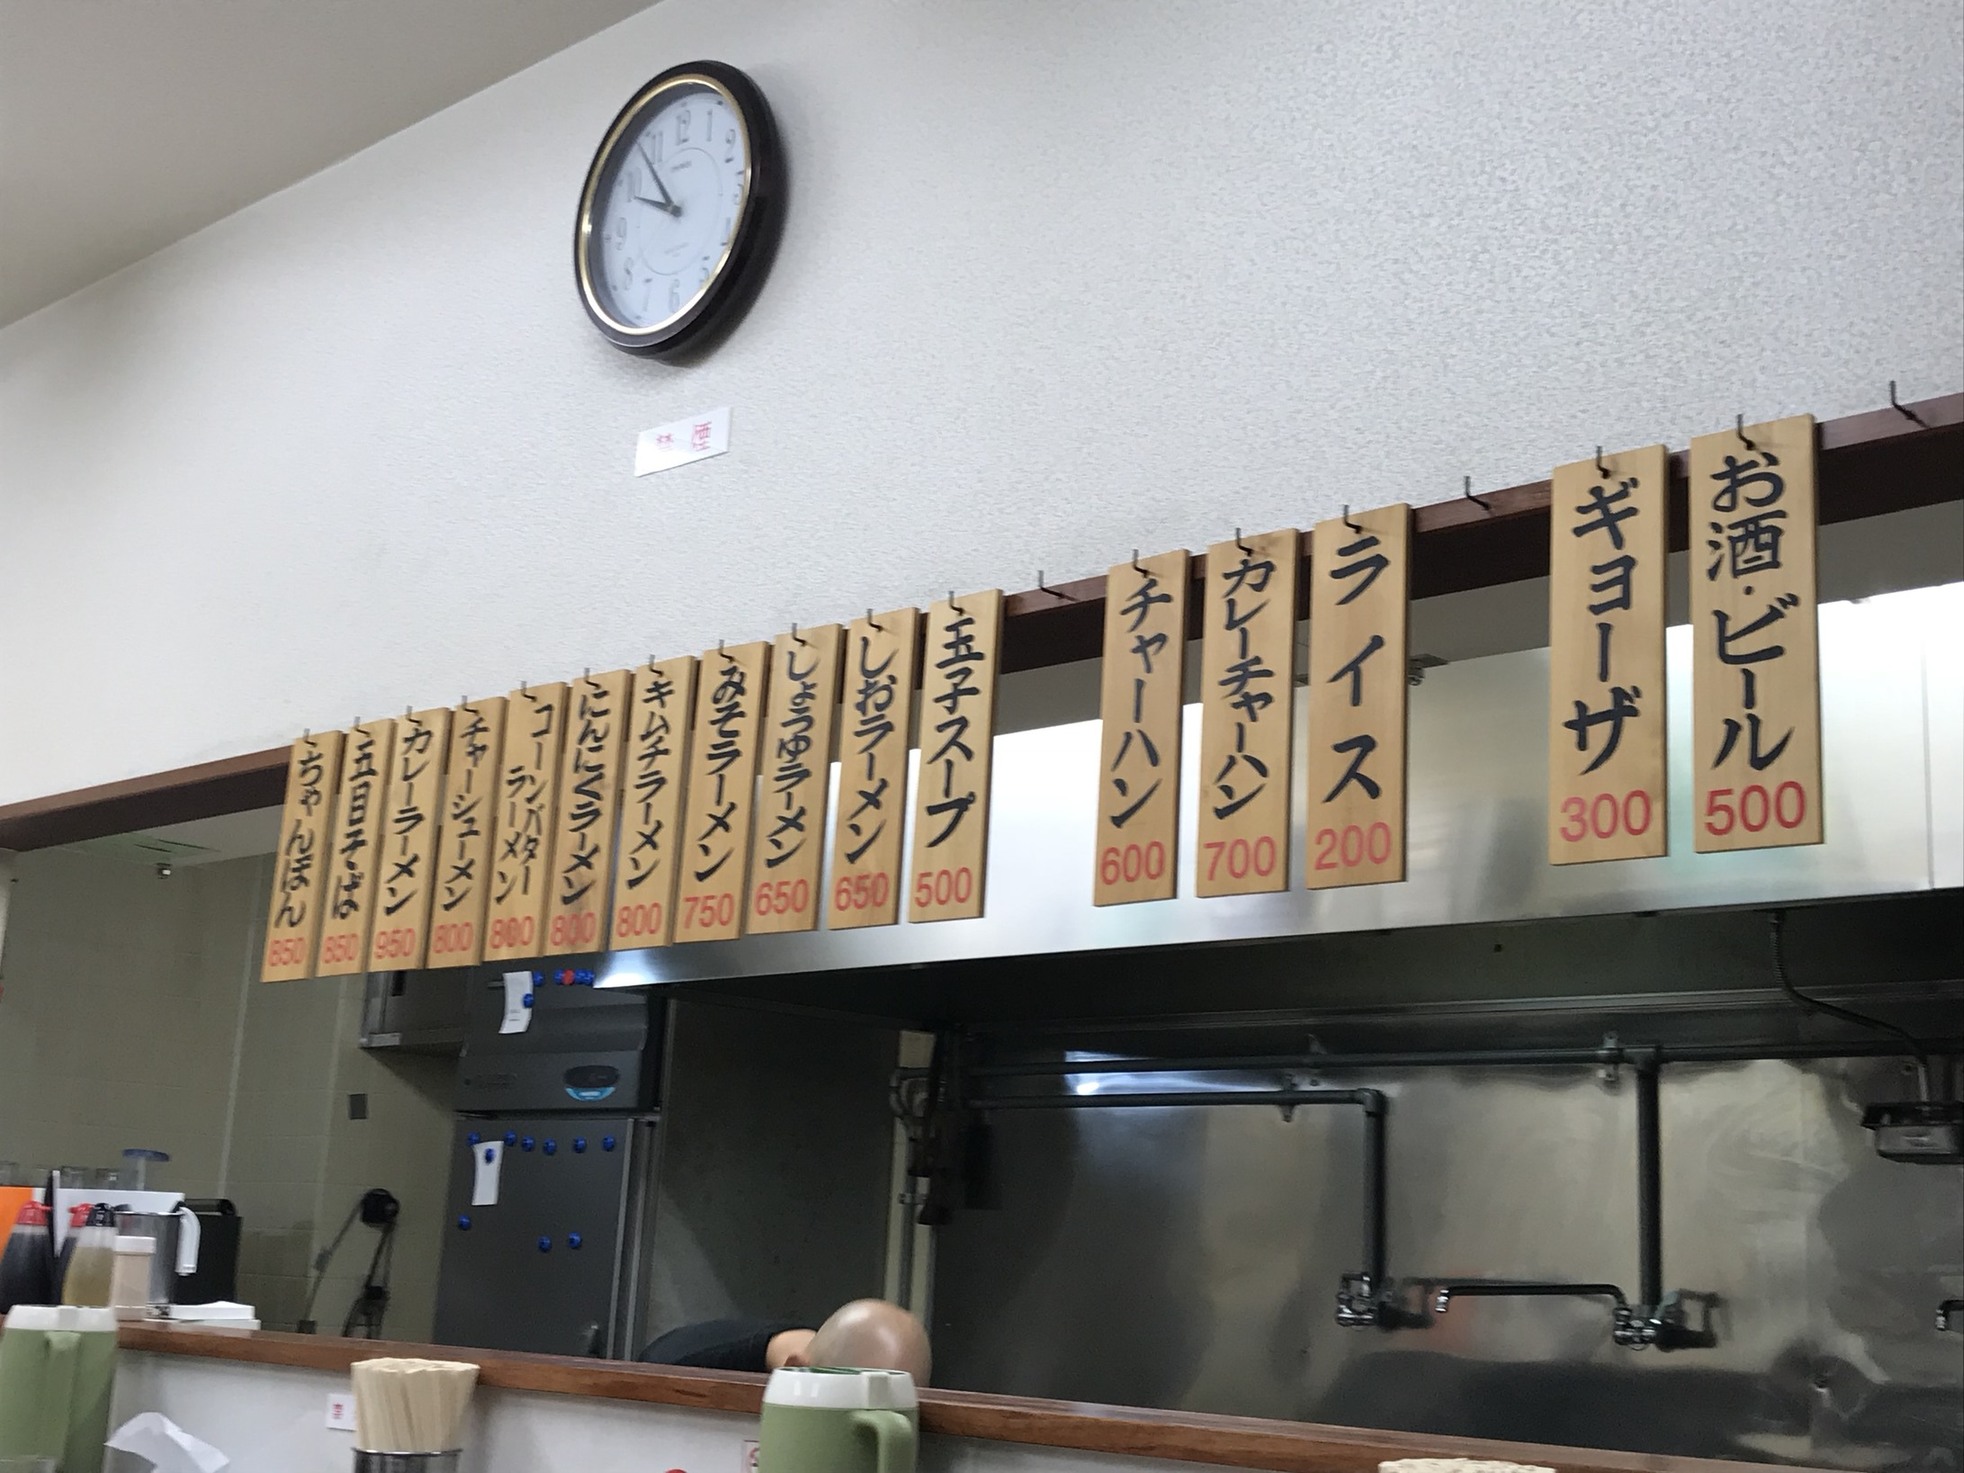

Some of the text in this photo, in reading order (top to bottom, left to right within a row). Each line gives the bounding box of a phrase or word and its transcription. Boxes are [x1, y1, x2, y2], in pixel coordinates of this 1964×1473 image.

[676, 110, 691, 146] 12
[725, 128, 737, 163] 2
[1562, 476, 1643, 776] ギョーザ
[1707, 452, 1801, 772] お酒・ビール
[1213, 558, 1276, 820] カレーチャーハン
[1321, 535, 1391, 804] ライス
[1110, 578, 1173, 829] チャーハン
[766, 650, 820, 869] しょうゆラーメン
[844, 635, 899, 864] しおラーメン
[927, 617, 986, 848] 玉子スープ
[561, 689, 610, 905] にんにくラーメン
[626, 681, 676, 890] キムチラーメン
[694, 665, 747, 882] みそラーメン
[331, 739, 378, 920] 五目そば
[384, 727, 433, 916] カレーラーメン
[442, 717, 490, 911] チャーシューメン
[1559, 789, 1653, 844] 300
[1704, 780, 1806, 837] 500
[1100, 840, 1166, 886] 600
[1204, 835, 1277, 882] 700
[1313, 821, 1392, 872] 200
[684, 892, 735, 929] 750
[754, 878, 809, 916] 650
[834, 871, 889, 912] 650
[913, 866, 973, 908] 500
[374, 927, 416, 960] 950
[489, 915, 534, 949] 800
[551, 912, 596, 947] 800
[616, 902, 663, 938] 800
